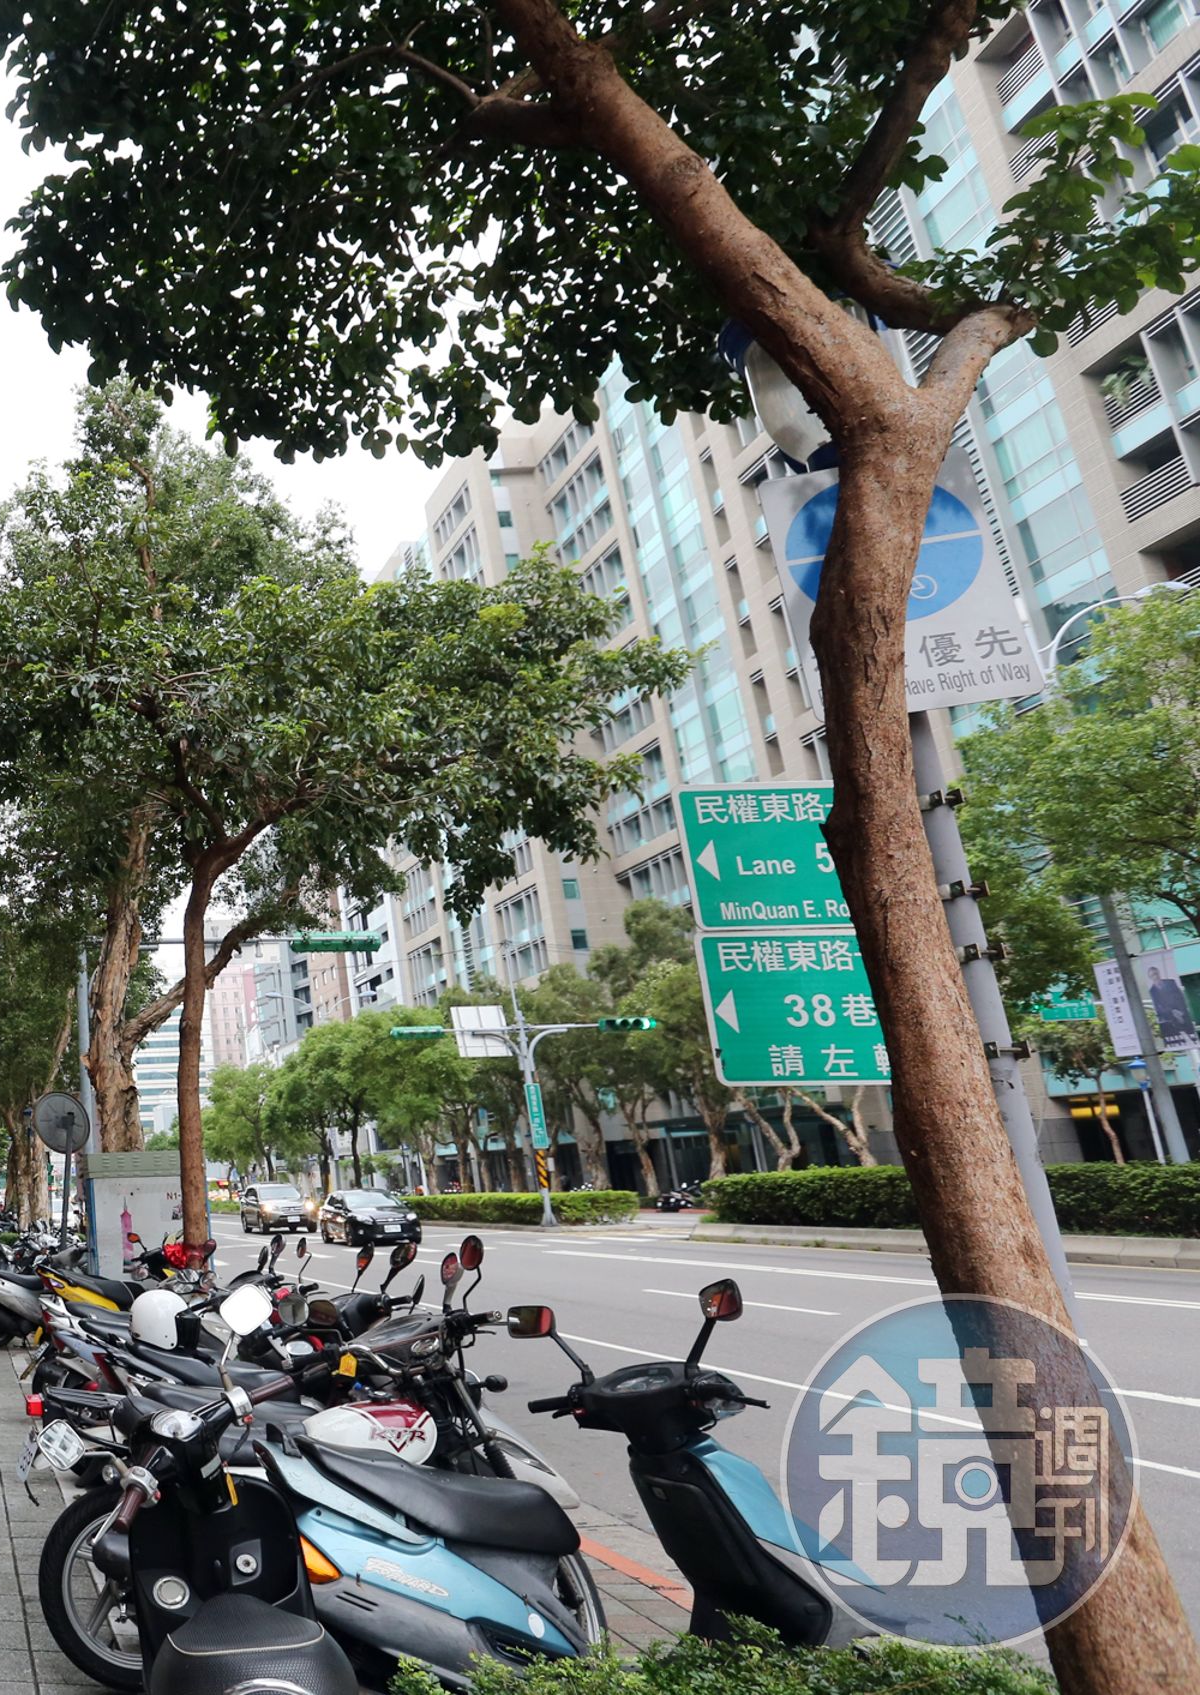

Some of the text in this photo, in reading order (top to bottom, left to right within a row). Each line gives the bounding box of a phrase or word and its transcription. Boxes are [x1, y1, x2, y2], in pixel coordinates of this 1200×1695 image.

[937, 669, 977, 693] Right
[980, 665, 995, 684] of
[996, 663, 1031, 682] Way
[694, 792, 834, 824] 民權東路
[736, 855, 796, 875] Lane
[720, 901, 799, 920] MinQuan
[802, 899, 822, 918] E.
[717, 940, 862, 972] 民權東路
